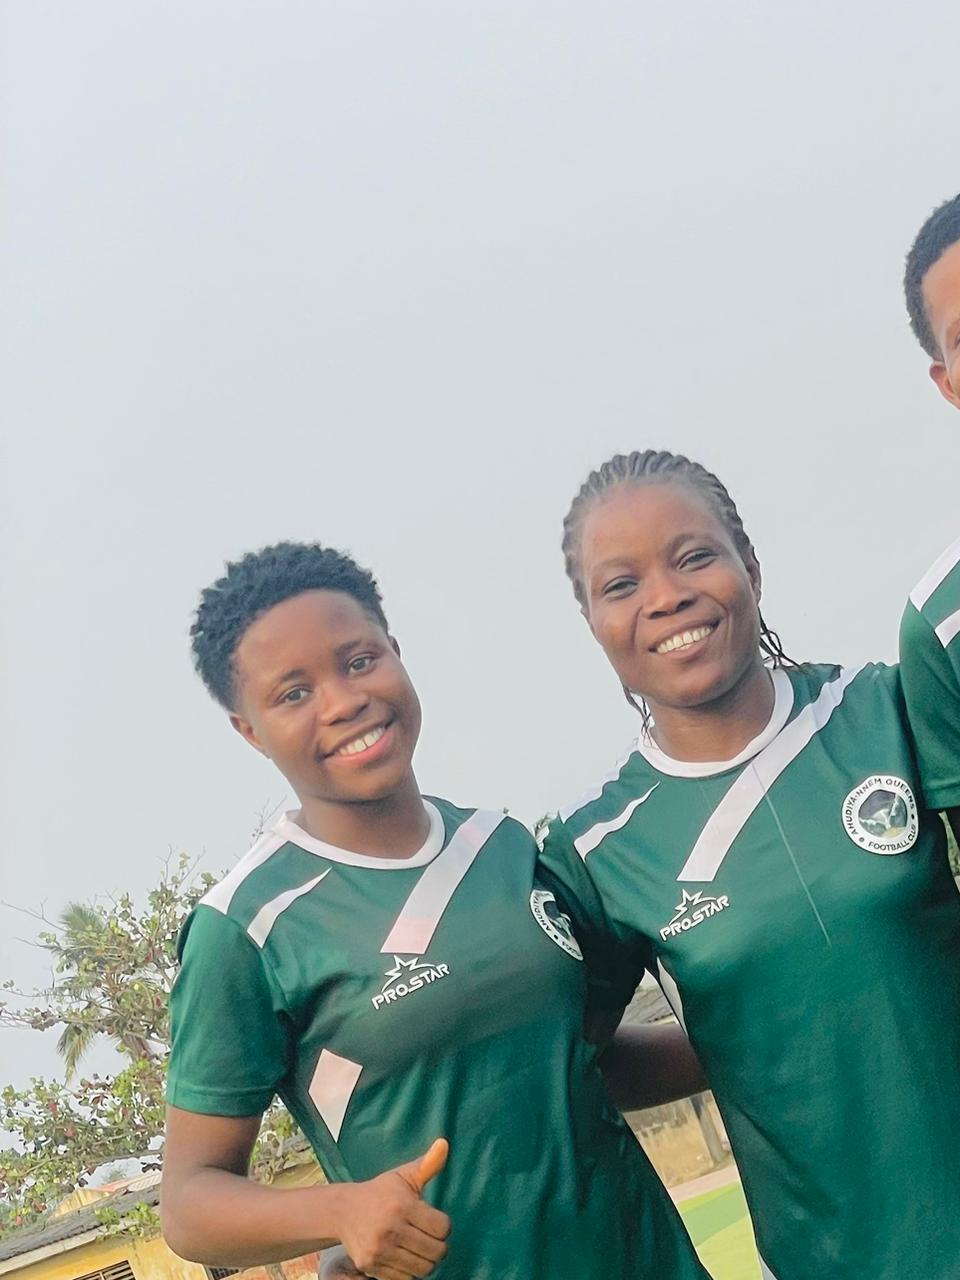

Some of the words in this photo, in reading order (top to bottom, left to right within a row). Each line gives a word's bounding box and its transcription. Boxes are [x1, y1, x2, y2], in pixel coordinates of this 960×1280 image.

[845, 778, 882, 836] AHUDIYA-NNEM
[885, 779, 915, 809] QUEENS
[868, 840, 910, 852] FOOTBALL
